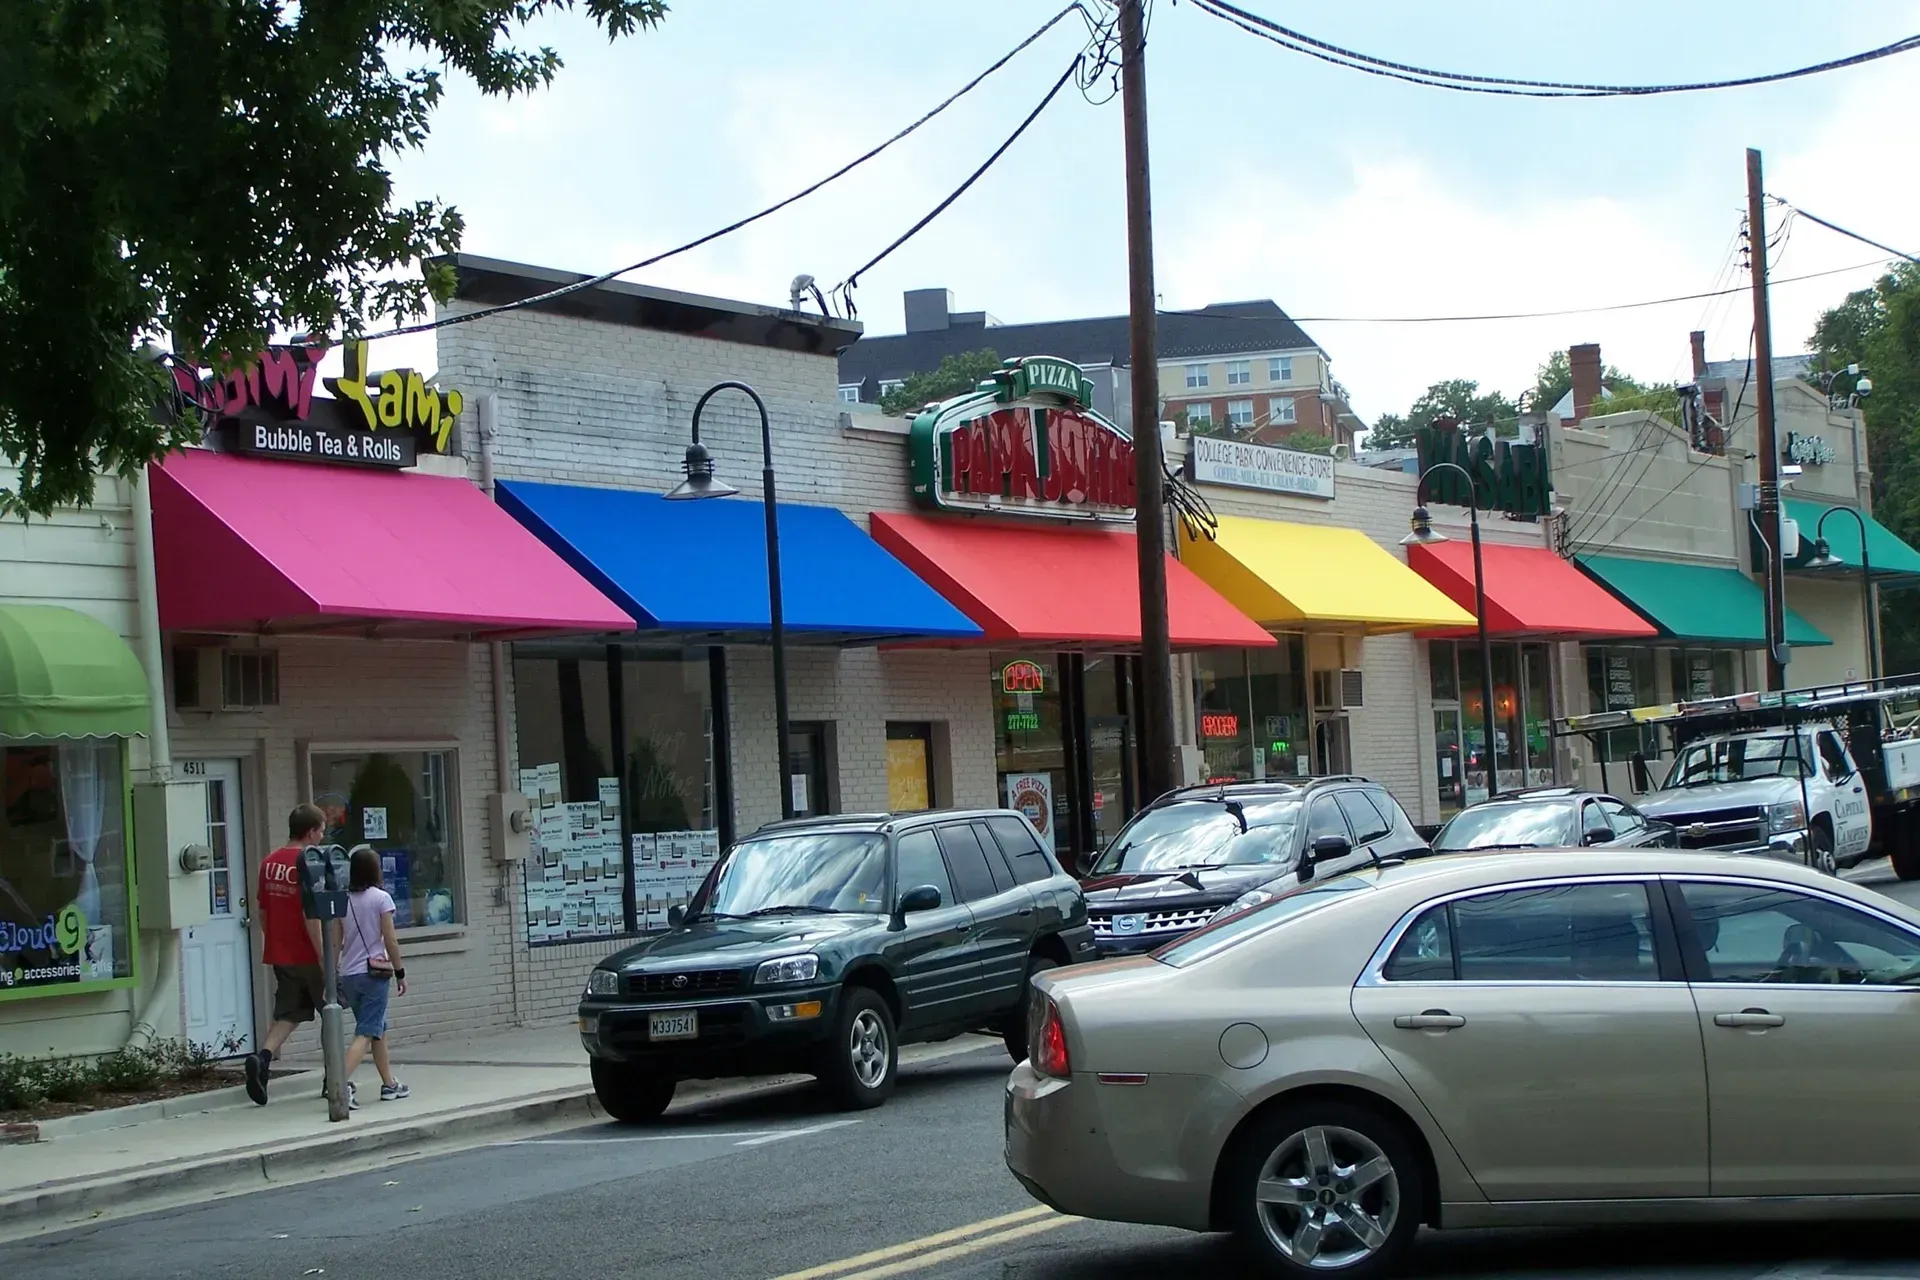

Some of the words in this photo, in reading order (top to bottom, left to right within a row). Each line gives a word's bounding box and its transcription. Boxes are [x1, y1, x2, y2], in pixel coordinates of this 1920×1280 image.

[1027, 363, 1079, 392] PIZZA
[254, 425, 311, 453] Bubble
[316, 431, 342, 456] Tea
[347, 436, 358, 457] &
[363, 438, 401, 462] Rolls
[946, 406, 1041, 501] PAPA
[1198, 440, 1233, 465] COLLEGE
[1235, 446, 1254, 468] PARK
[1256, 449, 1307, 476] CONVENIENCE
[1309, 457, 1332, 479] STORE
[1416, 428, 1551, 516] WASABI
[1005, 663, 1042, 690] OPEN
[1203, 716, 1237, 736] GROCERY
[183, 762, 206, 775] 4511
[1016, 777, 1031, 793] FREE
[1031, 778, 1049, 800] PIZZA
[1834, 798, 1865, 819] CAPITAL
[265, 862, 298, 885] UBC
[24, 962, 80, 980] accessories
[91, 958, 113, 978] gifts
